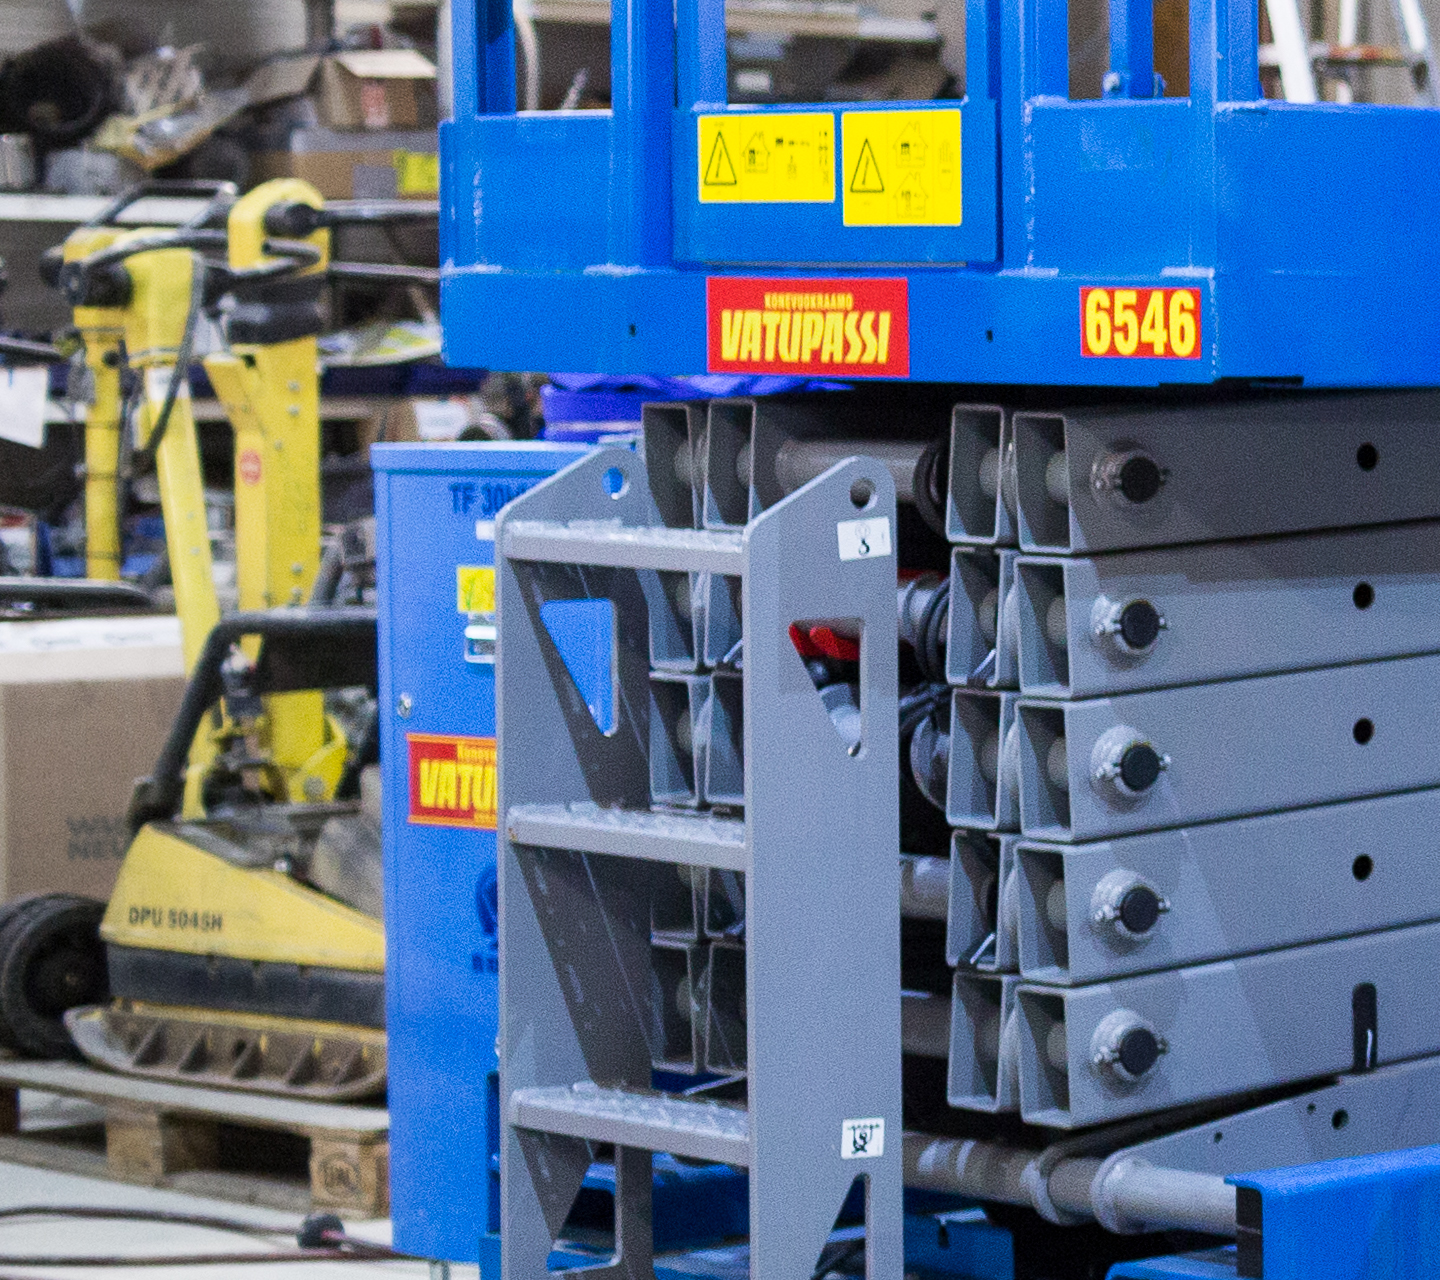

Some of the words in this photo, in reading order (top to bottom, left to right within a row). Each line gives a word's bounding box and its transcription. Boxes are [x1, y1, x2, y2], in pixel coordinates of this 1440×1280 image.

[721, 308, 891, 365] VATUPASSI
[1085, 287, 1196, 357] 6546
[419, 758, 498, 811] VATU
